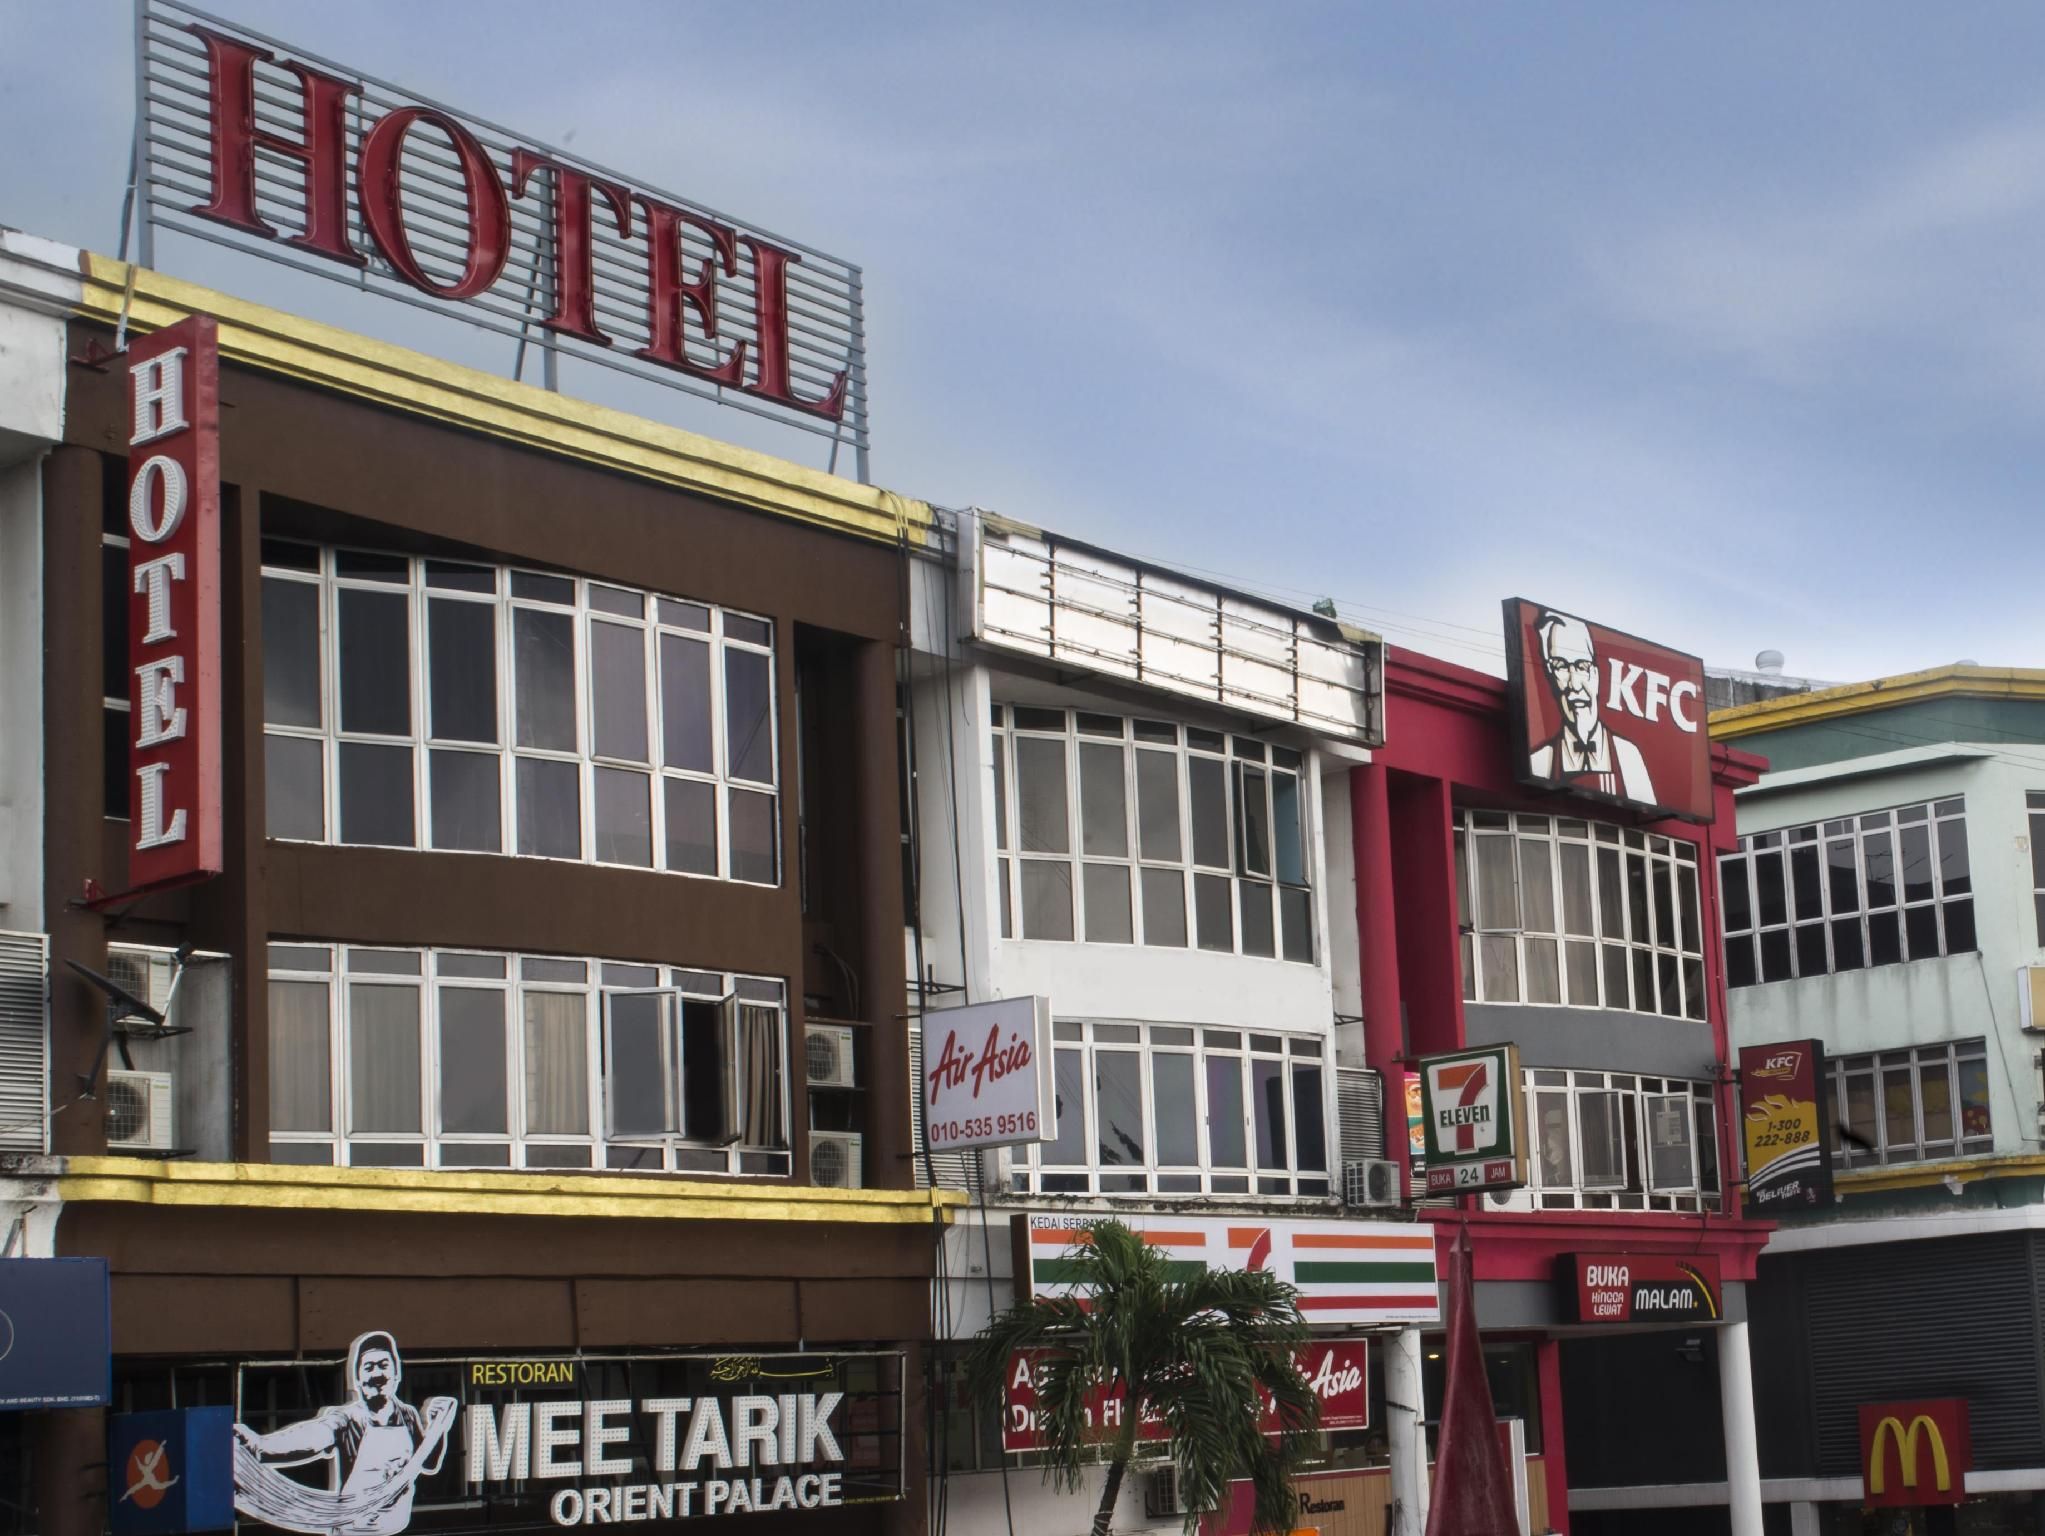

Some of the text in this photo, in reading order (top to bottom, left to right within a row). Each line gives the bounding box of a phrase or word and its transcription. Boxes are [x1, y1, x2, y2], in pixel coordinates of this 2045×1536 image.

[185, 22, 847, 422] HOTEL
[129, 346, 189, 850] HOTEL
[1606, 657, 1697, 733] KFC
[928, 1023, 1032, 1106] Air Asia
[1765, 1055, 1795, 1070] KFC
[931, 1111, 1036, 1142] 010-535 9516
[1767, 1118, 1802, 1132] 1-300
[1754, 1131, 1811, 1148] 222-888
[1430, 1167, 1507, 1185] BUKA 24 JAM
[1030, 1216, 1061, 1230] KEDAI
[1586, 1265, 1630, 1288] BUKA
[1593, 1303, 1624, 1317] LEWAT
[471, 1362, 574, 1385] RESTORAN
[1309, 1350, 1362, 1400] Asia
[465, 1392, 845, 1483] MEE TARIK
[550, 1472, 843, 1527] ORIENT PALACE
[1300, 1492, 1345, 1515] Restoran
